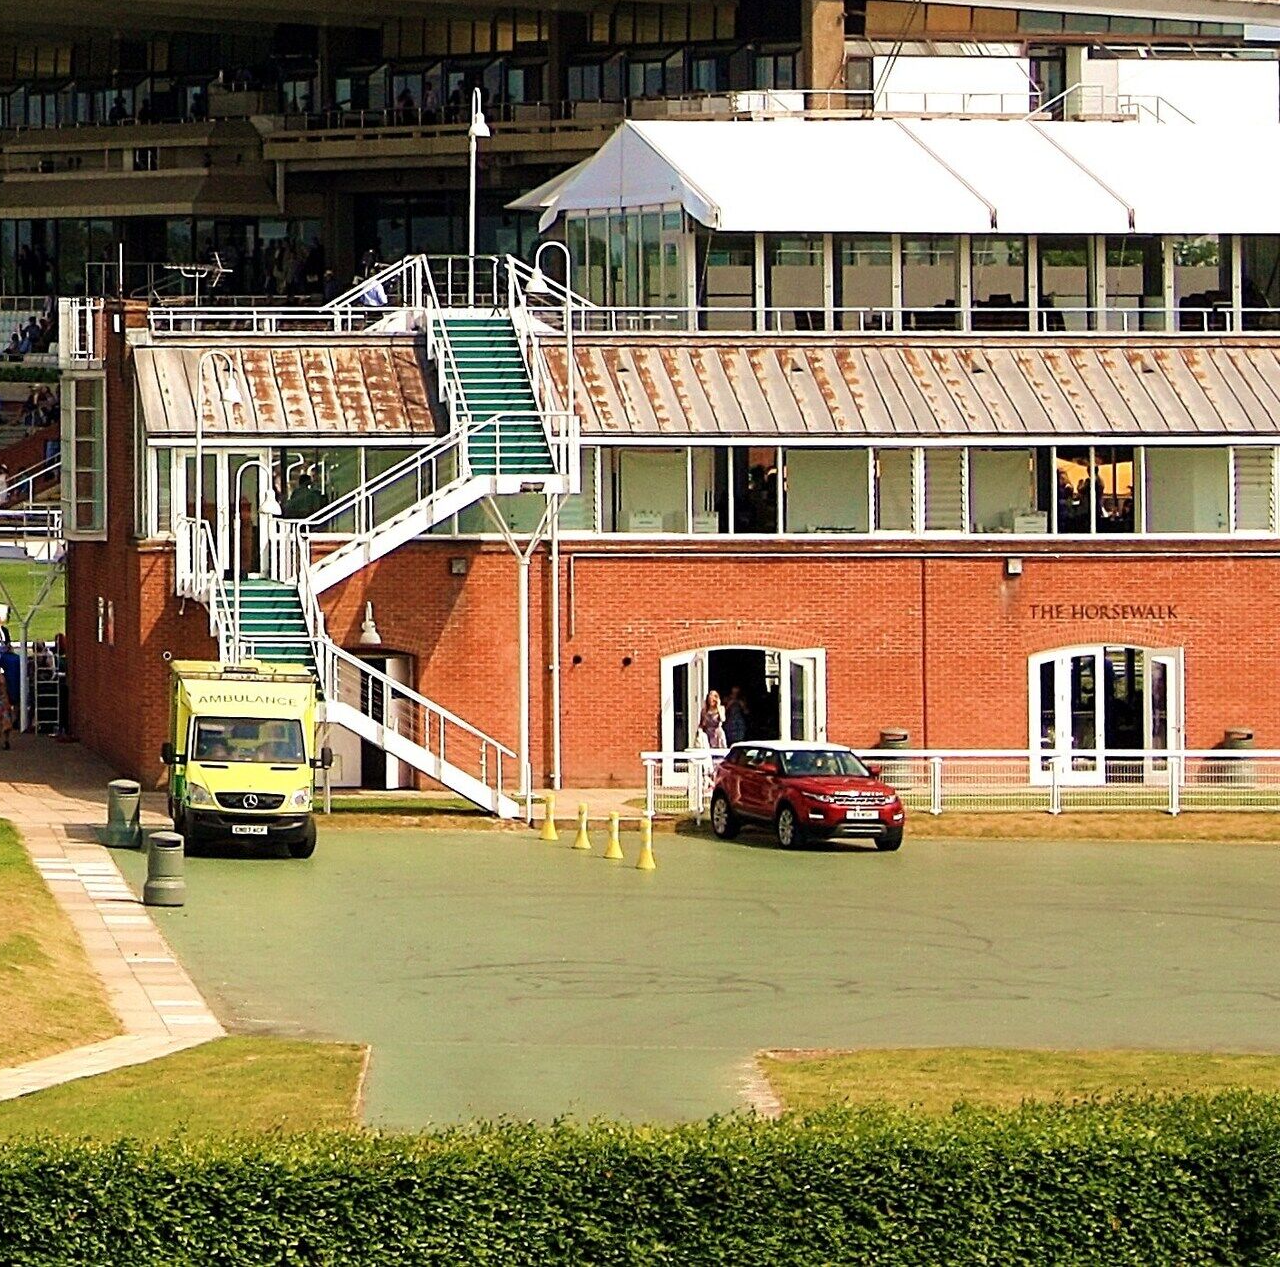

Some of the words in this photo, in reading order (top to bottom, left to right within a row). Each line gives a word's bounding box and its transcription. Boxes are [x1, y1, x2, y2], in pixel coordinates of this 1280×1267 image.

[1029, 604, 1065, 620] THE
[1070, 604, 1179, 620] HORSEWALK
[198, 694, 298, 708] AMBULANCE
